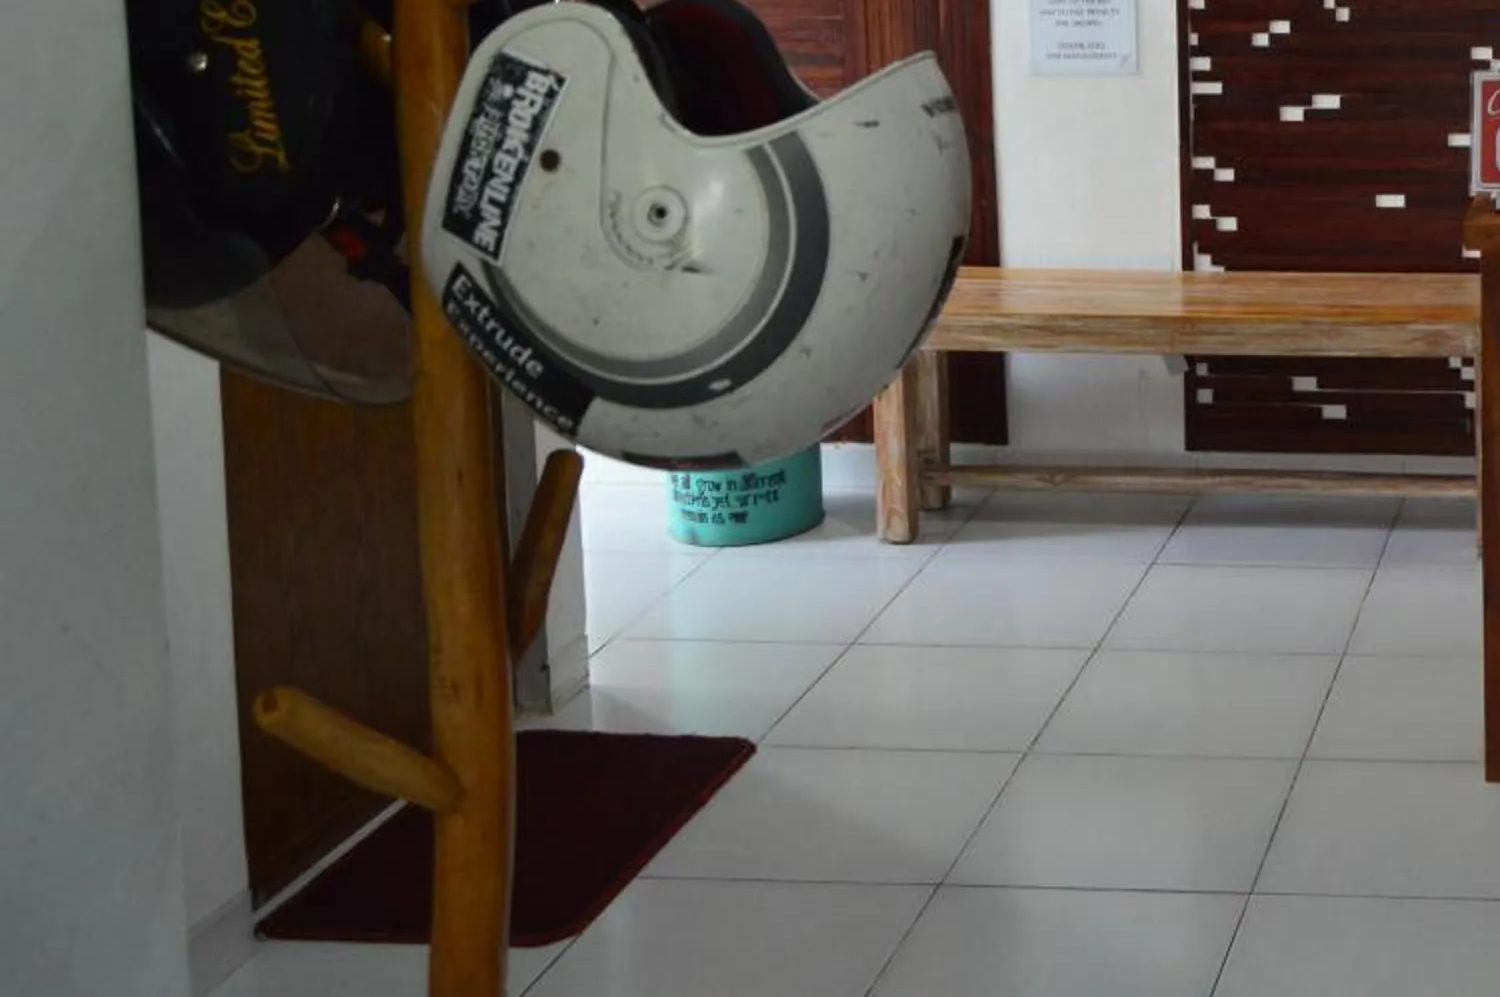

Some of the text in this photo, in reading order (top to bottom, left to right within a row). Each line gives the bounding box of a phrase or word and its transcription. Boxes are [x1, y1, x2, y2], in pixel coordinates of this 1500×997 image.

[212, 36, 289, 172] Limited
[474, 71, 550, 252] BROKENLINE
[452, 274, 544, 380] Extrude
